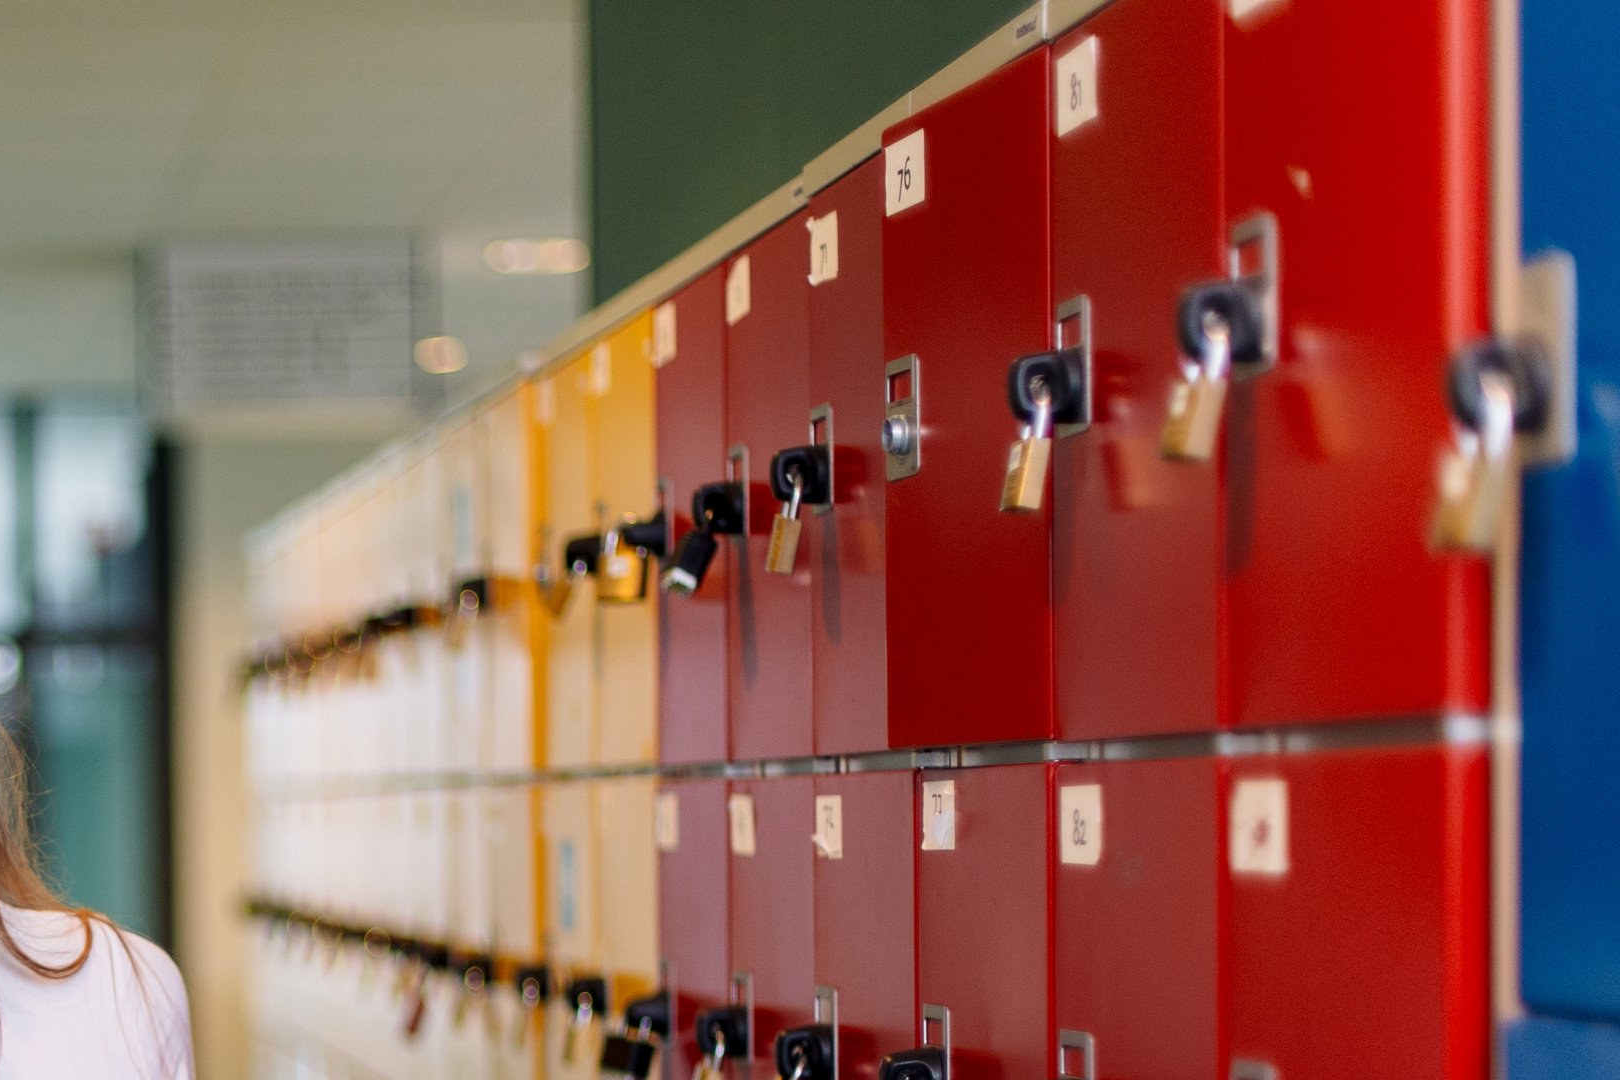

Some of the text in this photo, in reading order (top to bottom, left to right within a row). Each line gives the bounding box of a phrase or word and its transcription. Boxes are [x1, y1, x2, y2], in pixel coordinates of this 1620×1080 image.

[1069, 72, 1083, 111] 81
[897, 155, 912, 203] 76
[1072, 808, 1087, 846] 82
